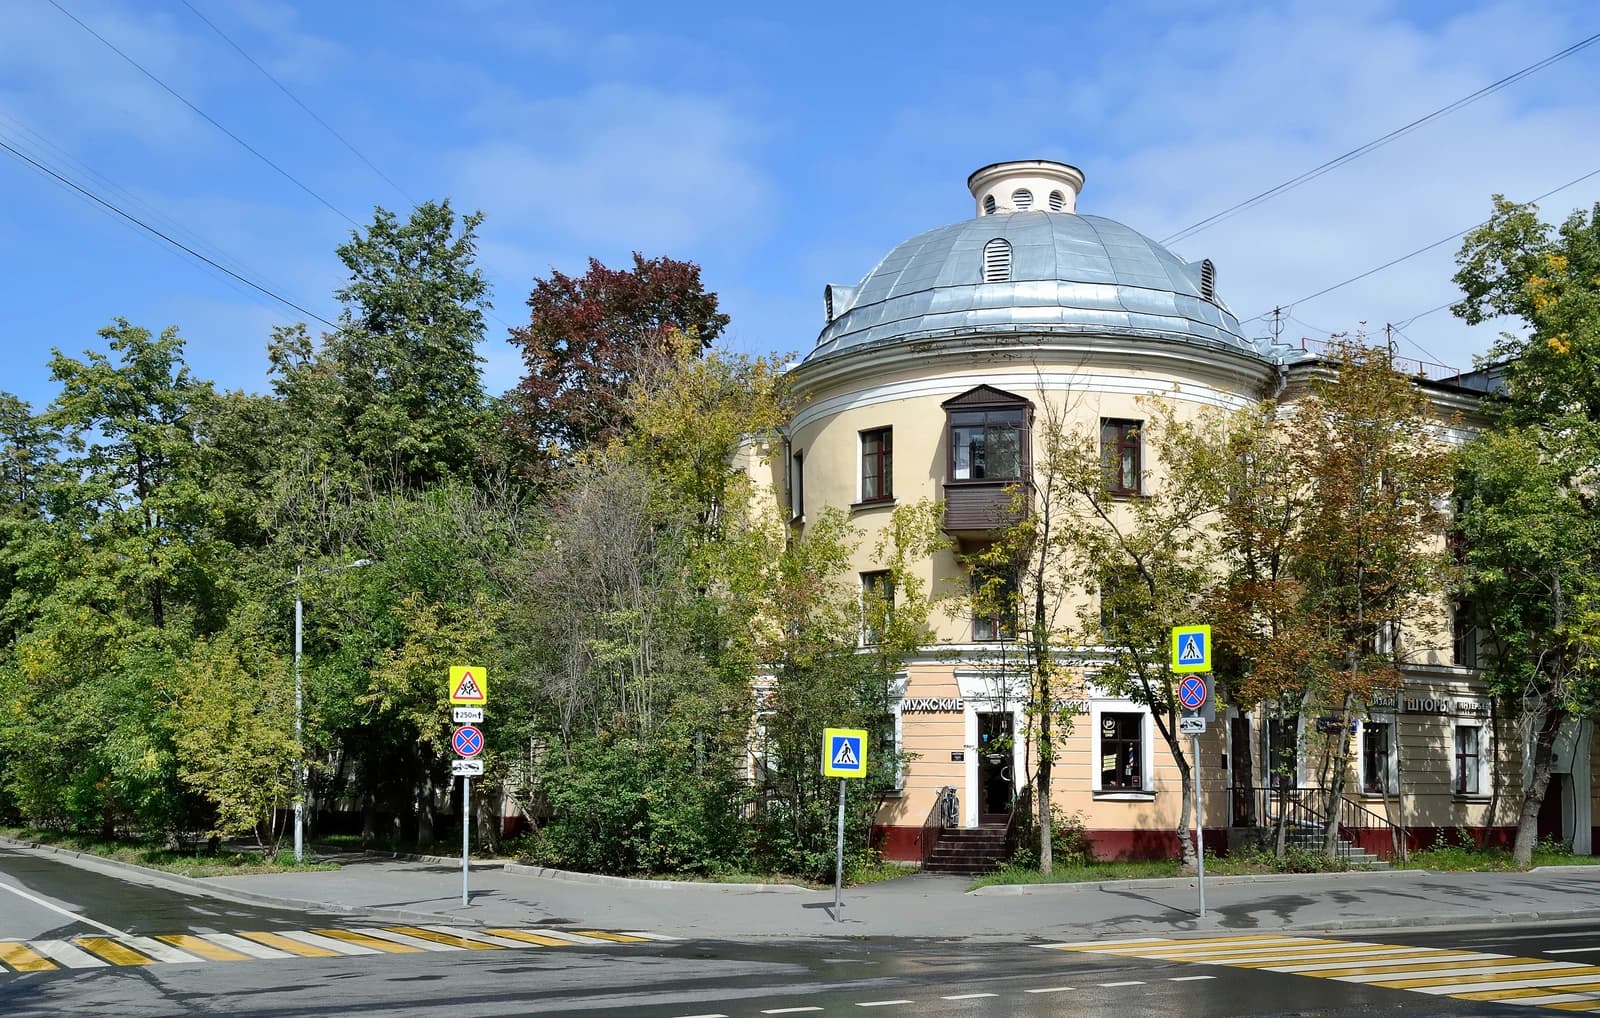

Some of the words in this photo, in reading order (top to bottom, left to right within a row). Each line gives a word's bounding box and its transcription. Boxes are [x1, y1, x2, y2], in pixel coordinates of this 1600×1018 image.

[901, 697, 964, 711] МУЖСКИЕ
[1407, 697, 1449, 712] ШТОРЫ
[459, 711, 478, 719] 250м
